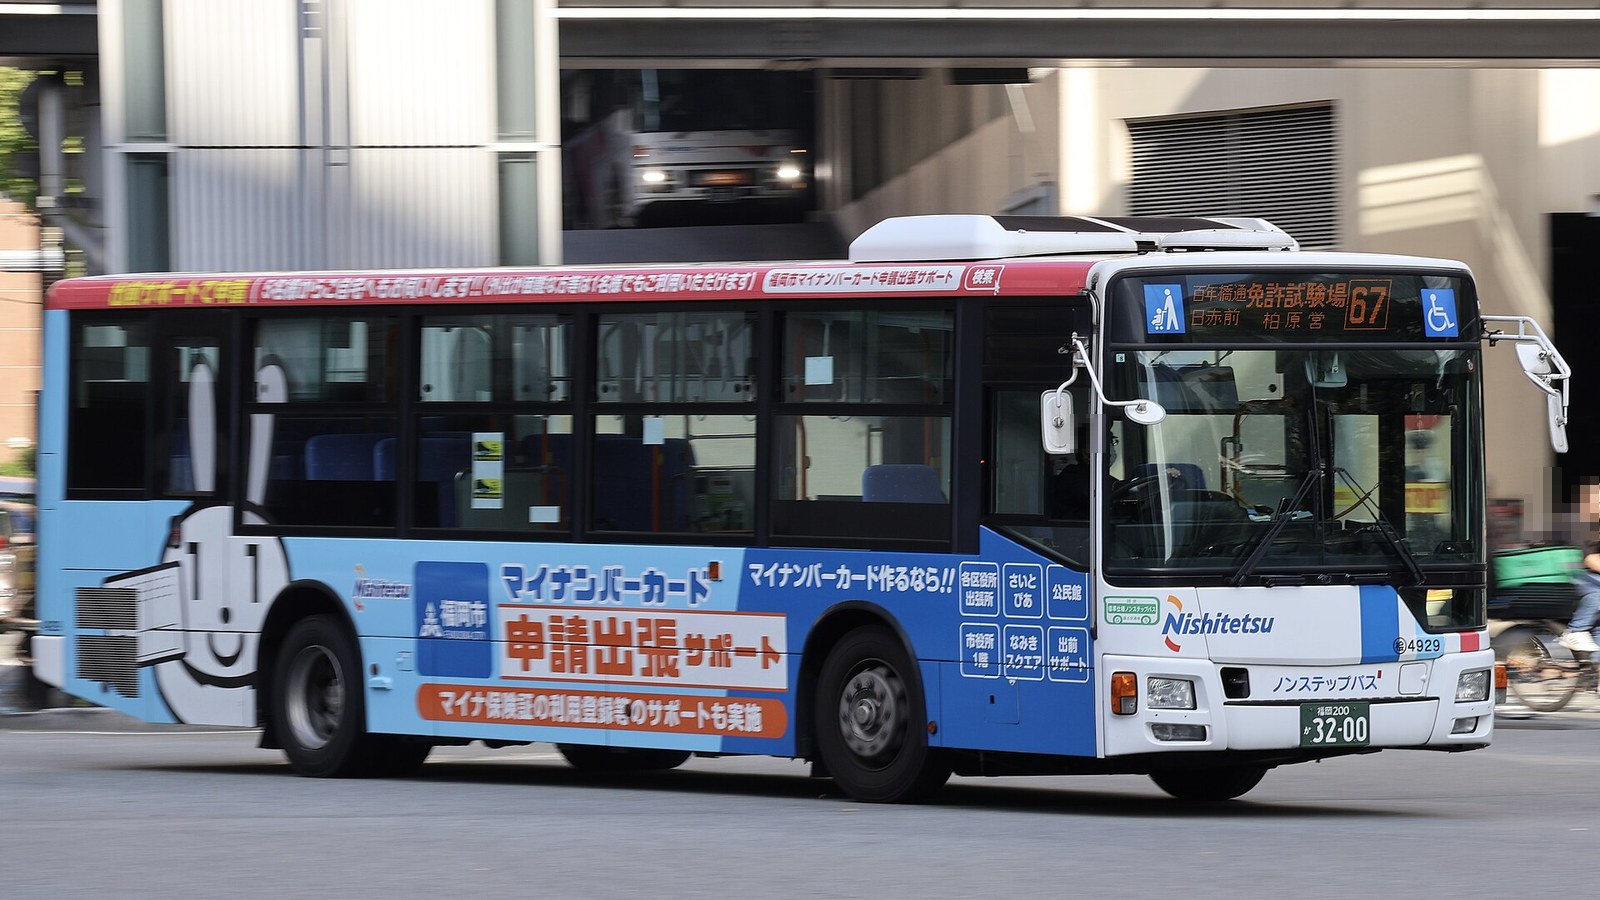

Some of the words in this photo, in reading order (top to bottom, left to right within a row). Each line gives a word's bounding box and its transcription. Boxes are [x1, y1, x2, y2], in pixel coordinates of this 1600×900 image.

[768, 269, 954, 288] 福岡市マイナンバーカード申請出張サポート
[971, 268, 996, 286] 検索
[1192, 284, 1247, 302] 百年橋通
[1246, 281, 1348, 309] 免許試験場
[1350, 286, 1387, 325] 67
[1190, 308, 1241, 327] 日赤前
[501, 562, 713, 608] マイナンバーカード
[961, 570, 998, 589] 各区役所
[1008, 573, 1037, 590] さいと
[965, 590, 994, 608] 出張所
[1052, 583, 1082, 602] 公民館
[440, 599, 487, 628] 福岡市
[1161, 612, 1275, 635] Nishitetsu
[505, 613, 781, 678] 申請出張サポート
[965, 631, 995, 650] 市役所
[1009, 634, 1038, 651] なみき
[1058, 636, 1078, 654] 出前
[1408, 639, 1441, 652] 4929
[1006, 653, 1042, 671] スクエア
[1050, 656, 1087, 673] サポート
[1272, 675, 1378, 693] ノンステップバス
[1312, 716, 1367, 744] 32-00
